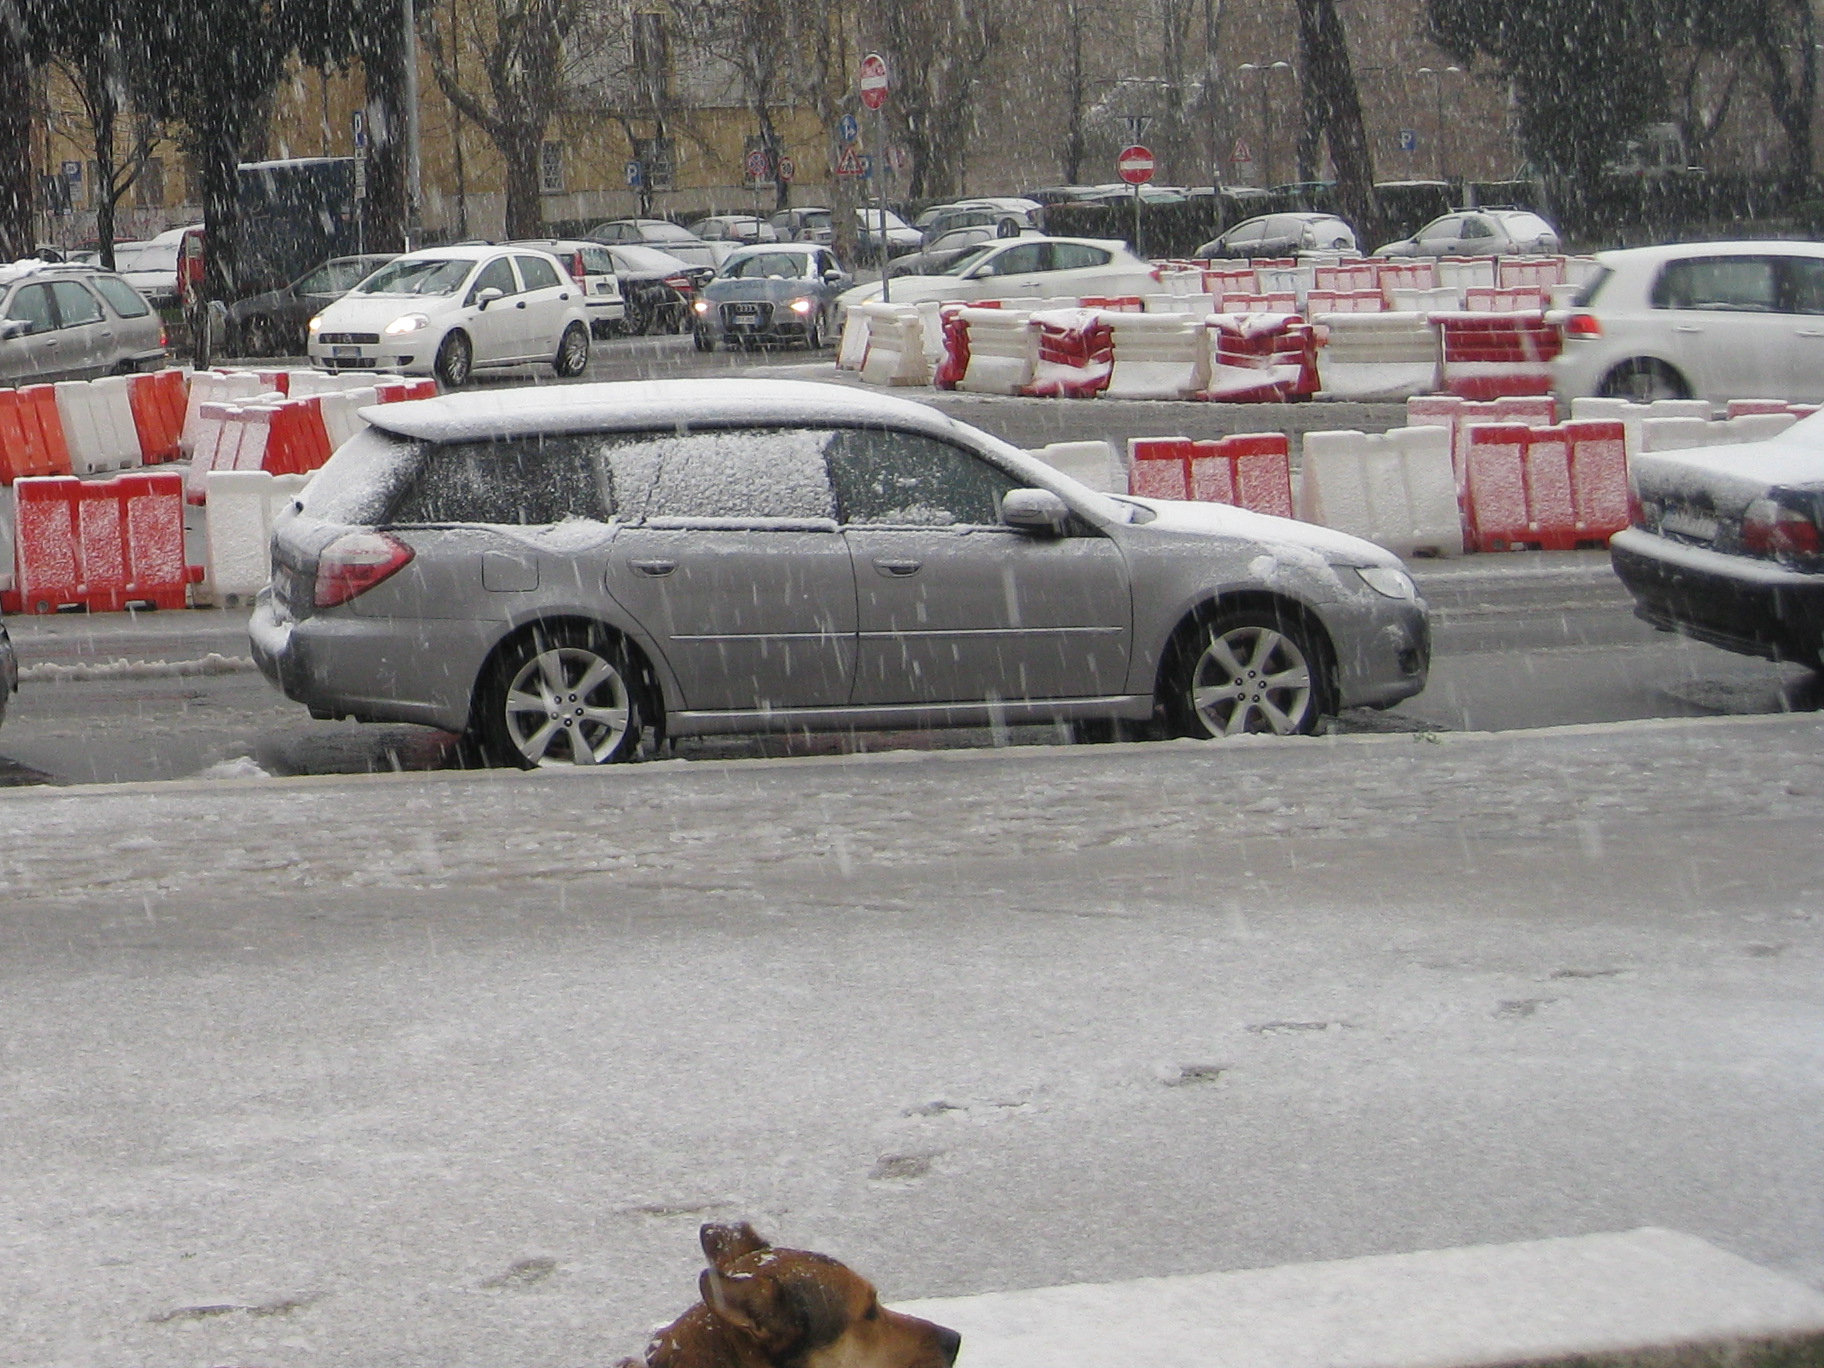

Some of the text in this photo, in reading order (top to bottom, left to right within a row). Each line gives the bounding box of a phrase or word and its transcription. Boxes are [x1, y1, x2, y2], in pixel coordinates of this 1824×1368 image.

[354, 114, 361, 143] P
[1401, 131, 1412, 148] P
[627, 164, 637, 184] P
